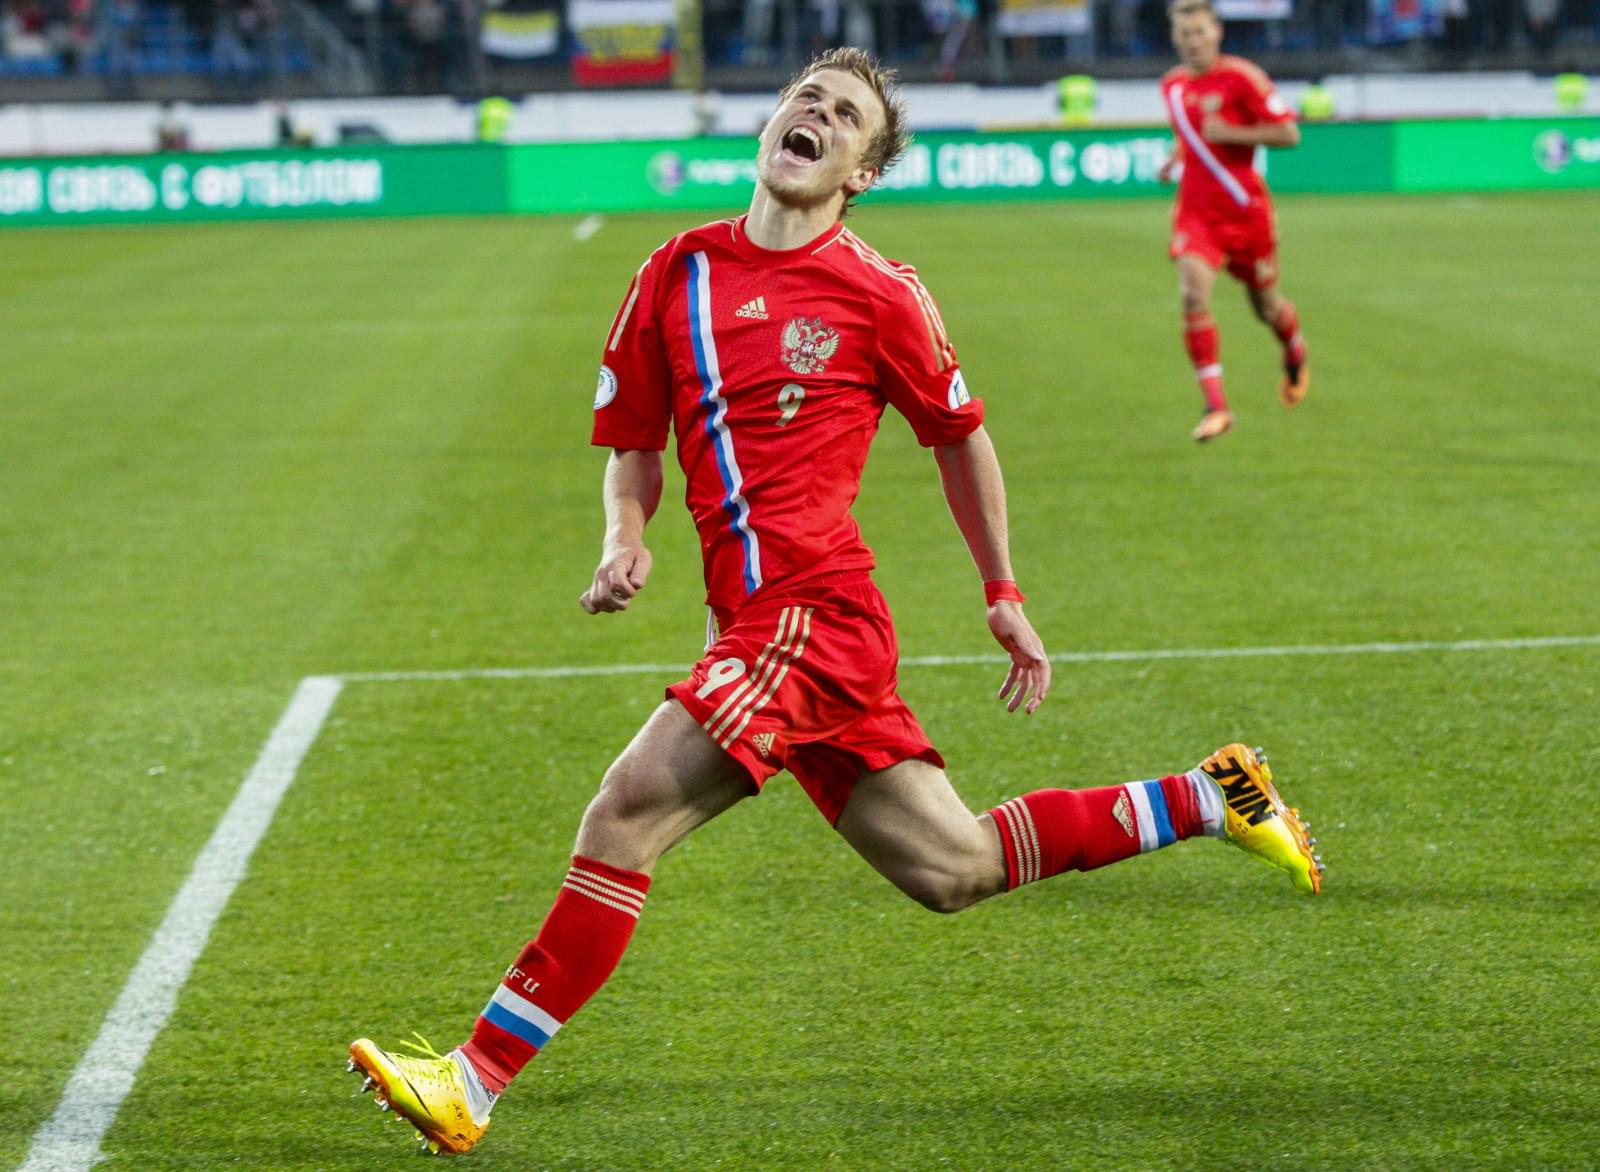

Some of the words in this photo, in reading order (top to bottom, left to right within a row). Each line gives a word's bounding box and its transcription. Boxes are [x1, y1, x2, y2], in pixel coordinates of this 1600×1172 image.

[735, 309, 769, 320] adidas
[774, 383, 806, 427] 9
[695, 657, 747, 700] 9
[1200, 756, 1278, 827] NIKE
